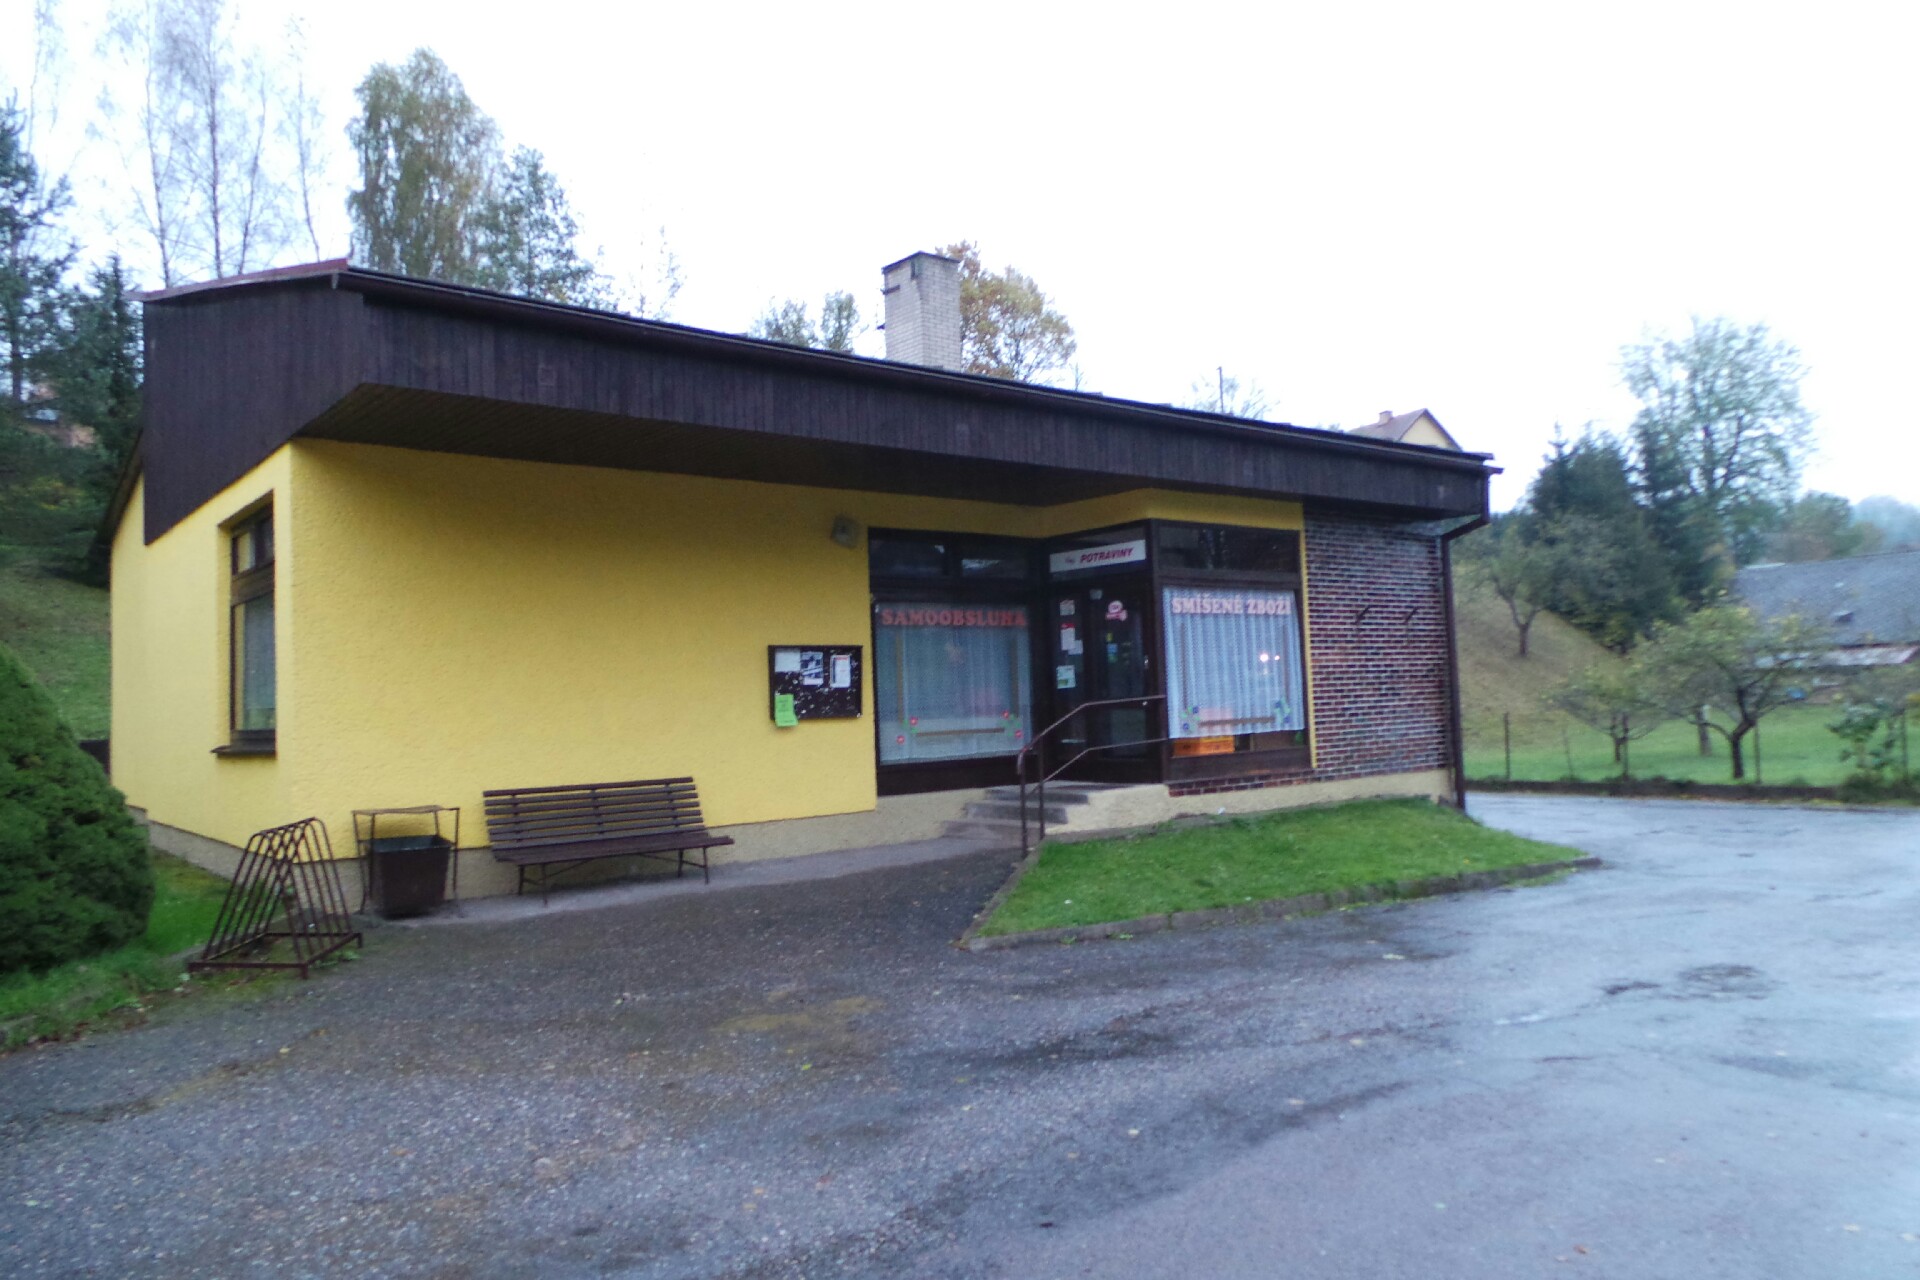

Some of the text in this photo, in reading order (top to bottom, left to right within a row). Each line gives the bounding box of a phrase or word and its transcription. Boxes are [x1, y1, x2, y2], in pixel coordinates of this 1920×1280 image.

[1079, 547, 1134, 563] POTRAVINY
[1172, 592, 1243, 614] SMÍŠENÉ
[881, 608, 1027, 626] SAMOOBSLUHA
